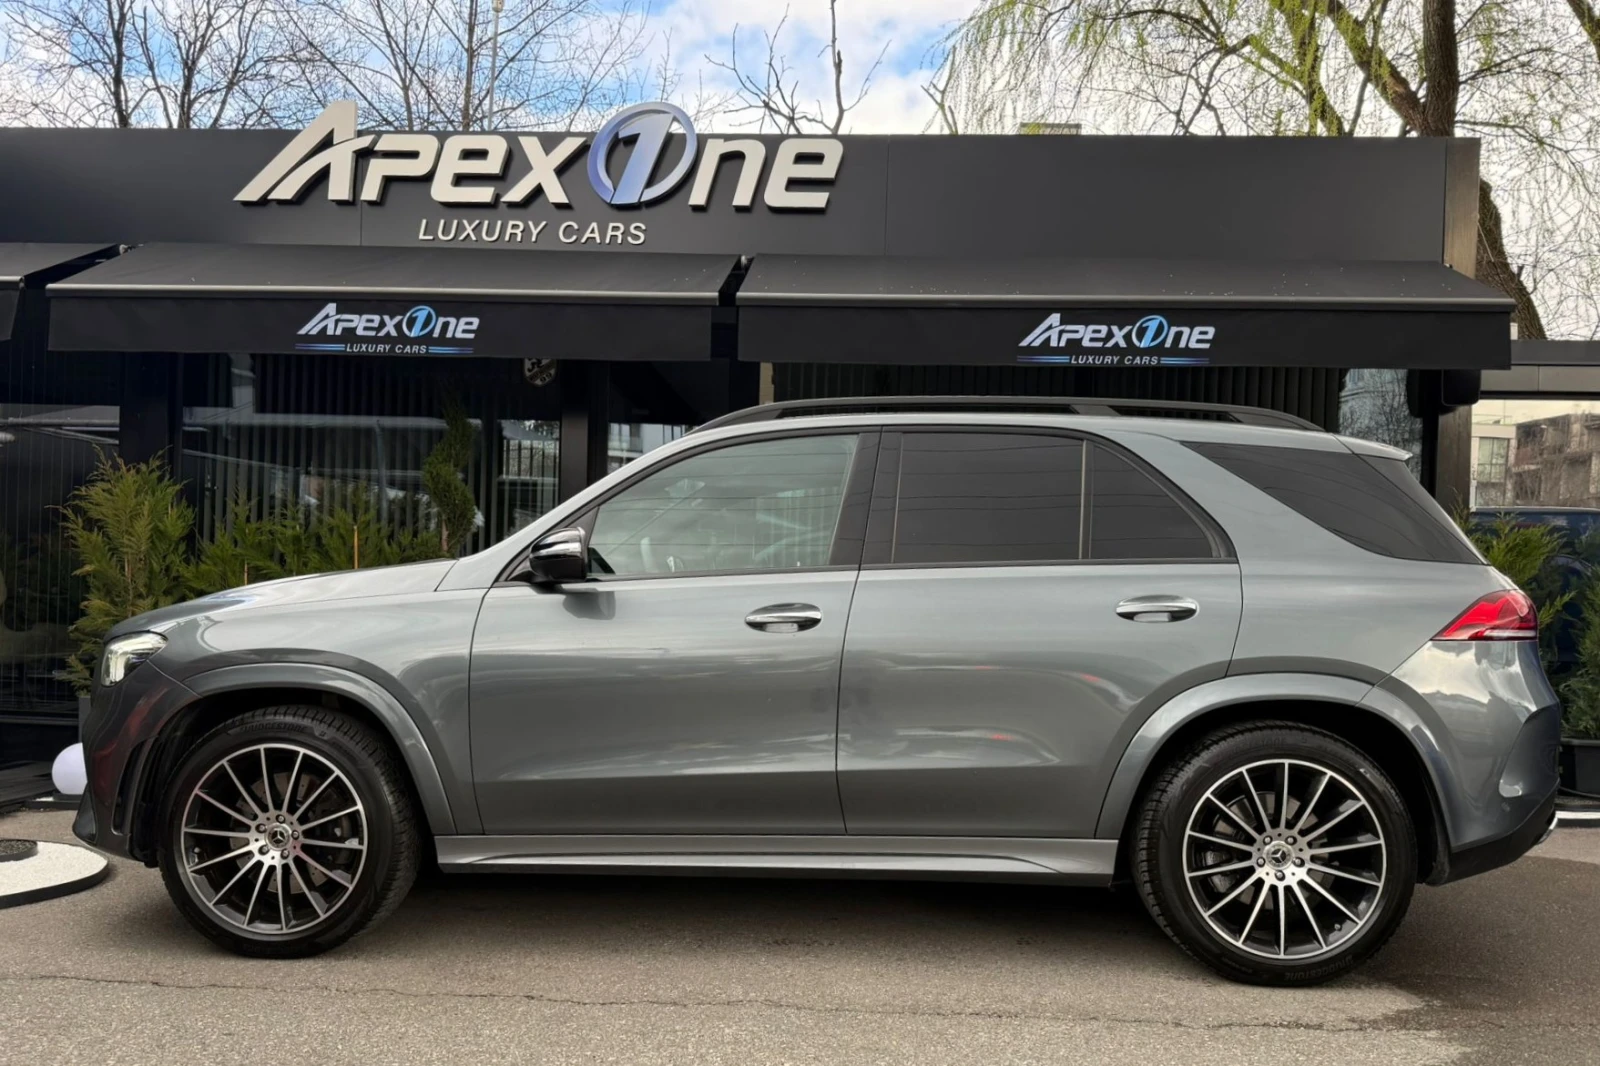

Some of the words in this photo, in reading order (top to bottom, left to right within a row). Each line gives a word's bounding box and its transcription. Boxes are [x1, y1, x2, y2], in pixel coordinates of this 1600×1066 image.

[418, 218, 547, 243] LUXURY
[558, 221, 647, 245] CARS
[346, 343, 391, 353] LUXURY
[395, 344, 427, 354] CARS
[1071, 355, 1120, 365] LUXURY
[1124, 356, 1159, 365] CARS
